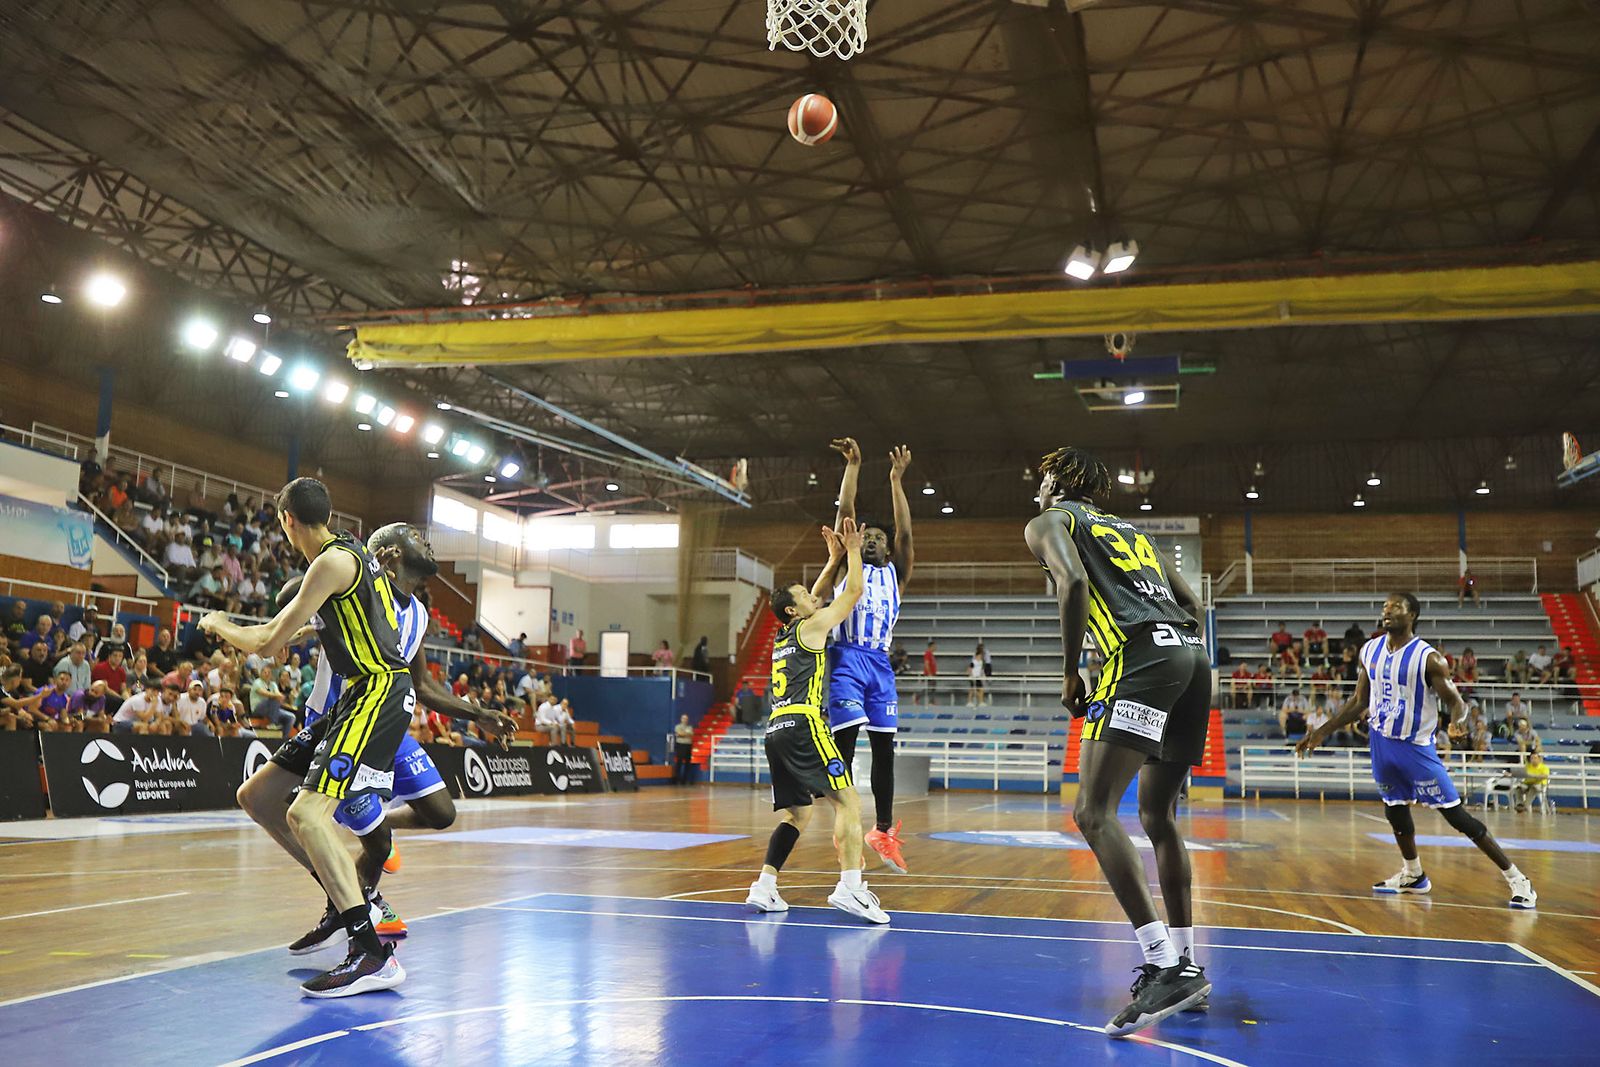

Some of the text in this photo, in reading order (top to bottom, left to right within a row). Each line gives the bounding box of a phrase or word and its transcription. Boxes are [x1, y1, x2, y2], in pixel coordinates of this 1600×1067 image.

[1091, 524, 1165, 583] 34
[771, 659, 787, 698] 5
[131, 747, 201, 774] Andalucía
[486, 755, 530, 772] baloncesto
[603, 751, 632, 773] Huelva
[135, 779, 197, 791] Región Europea del
[136, 791, 170, 800] DEPORTE
